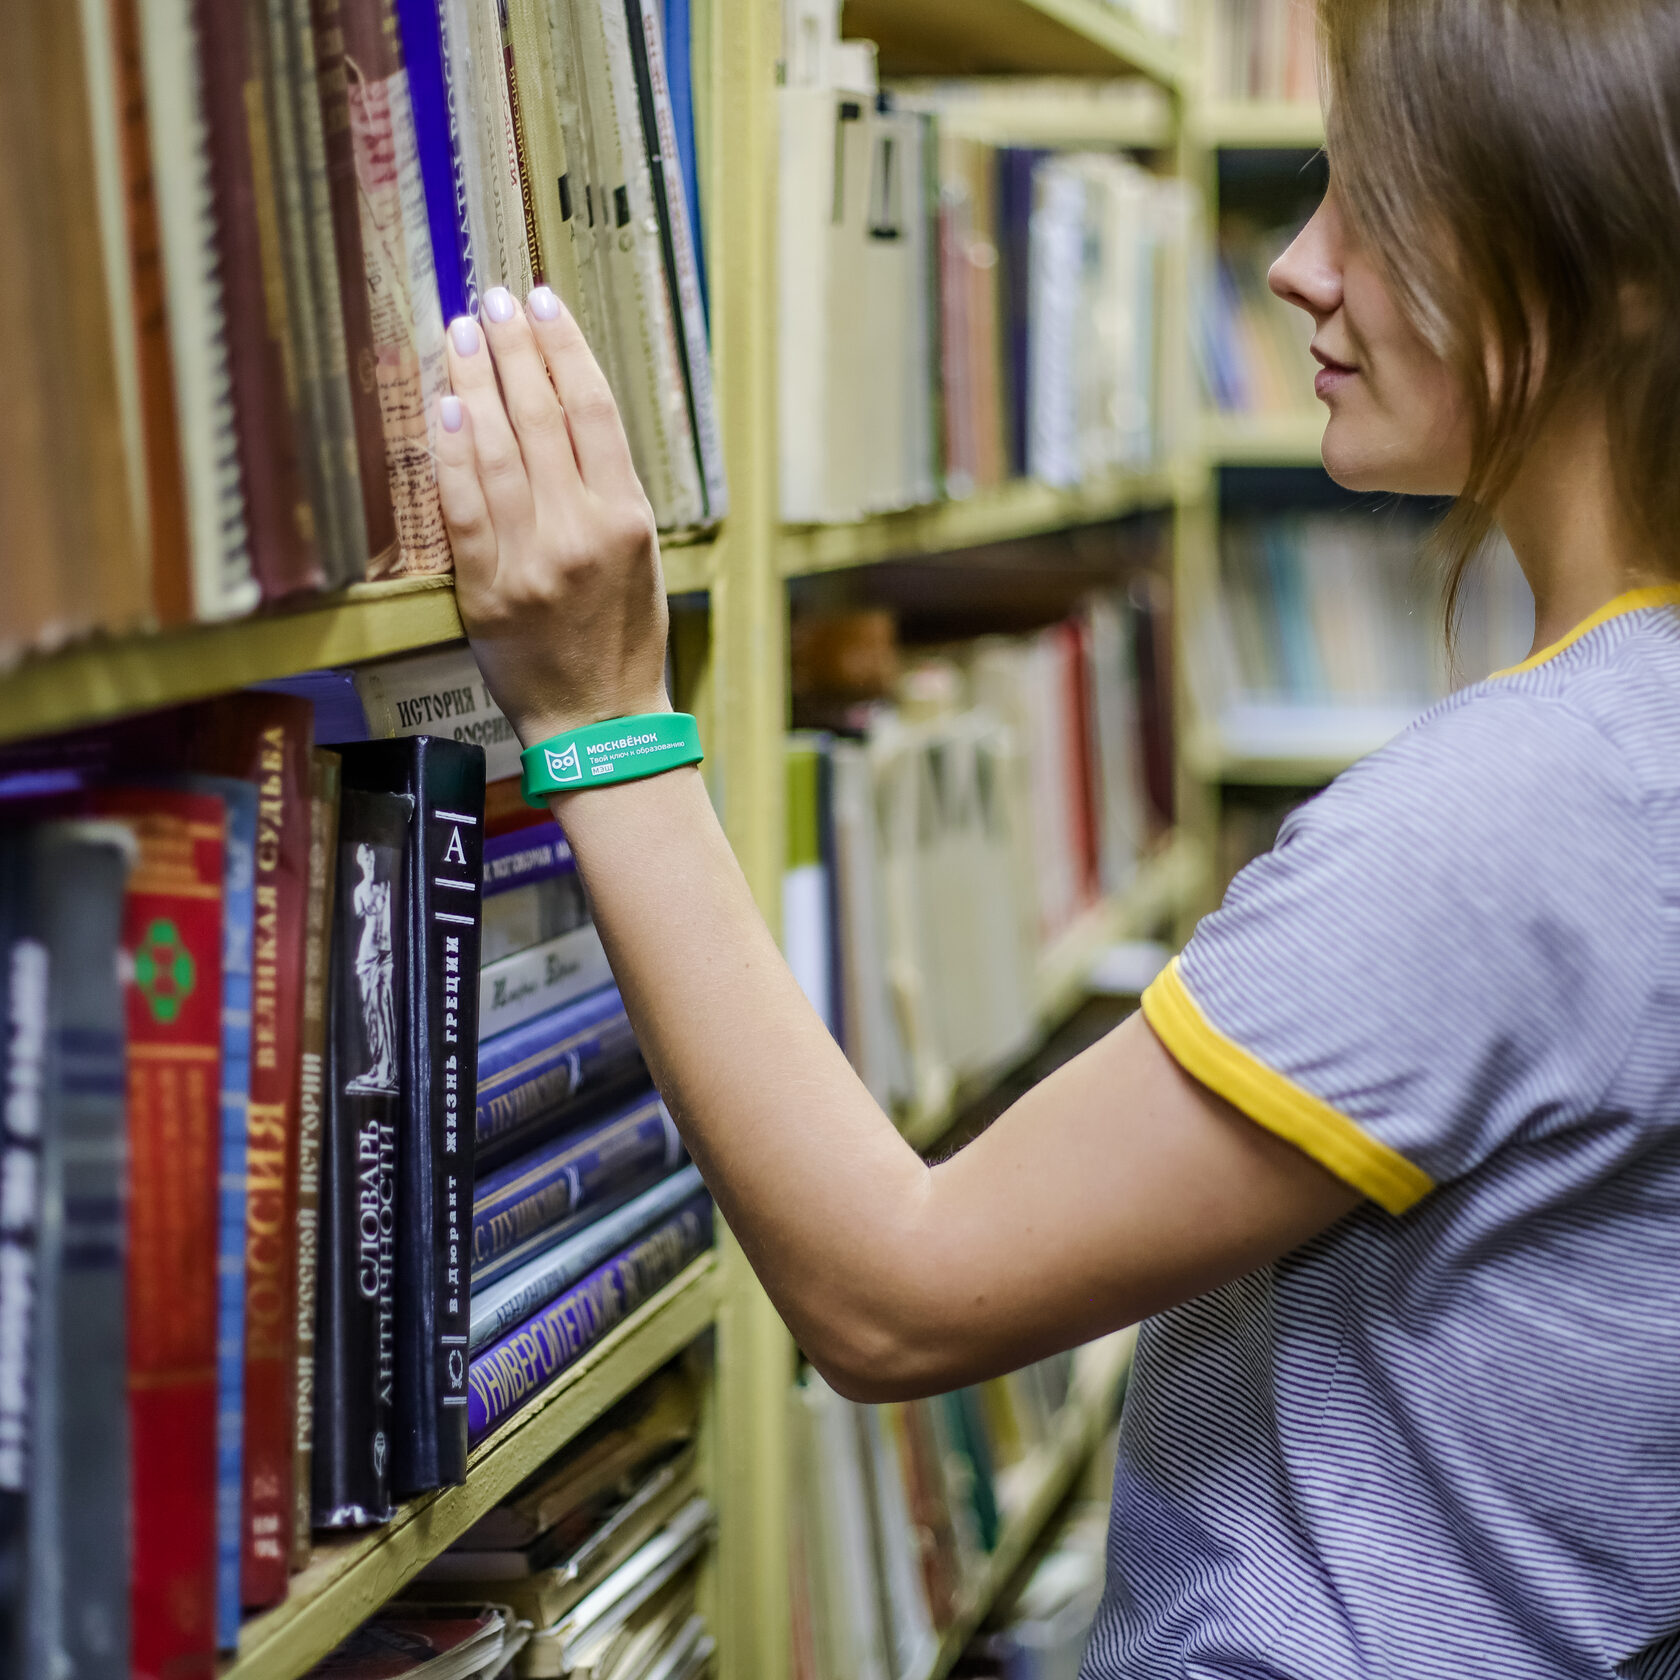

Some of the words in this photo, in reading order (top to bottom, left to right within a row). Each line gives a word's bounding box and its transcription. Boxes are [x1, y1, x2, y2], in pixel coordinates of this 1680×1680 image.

[510, 65, 540, 278] ЭНЦИКЛОПЕДИЧЕСКИЙ
[396, 686, 476, 728] ИСТОРИЯ
[586, 732, 659, 756] МОСКВЁНОК
[589, 754, 609, 765] Твой
[609, 751, 630, 761] ключ
[636, 741, 685, 754] образованию
[258, 726, 284, 873] СУДЬБА
[591, 764, 612, 775] МЭШ
[444, 825, 467, 865] А
[256, 885, 278, 1069] ВЕЛИКАЯ
[445, 935, 461, 1044] ГРЕЦИИ
[445, 1055, 458, 1153] ЖИЗНЬ
[245, 1101, 286, 1361] РОССИЯ
[359, 1119, 380, 1298] СЛОВАРЬ
[379, 1125, 395, 1406] АНТИЧНОСТИ
